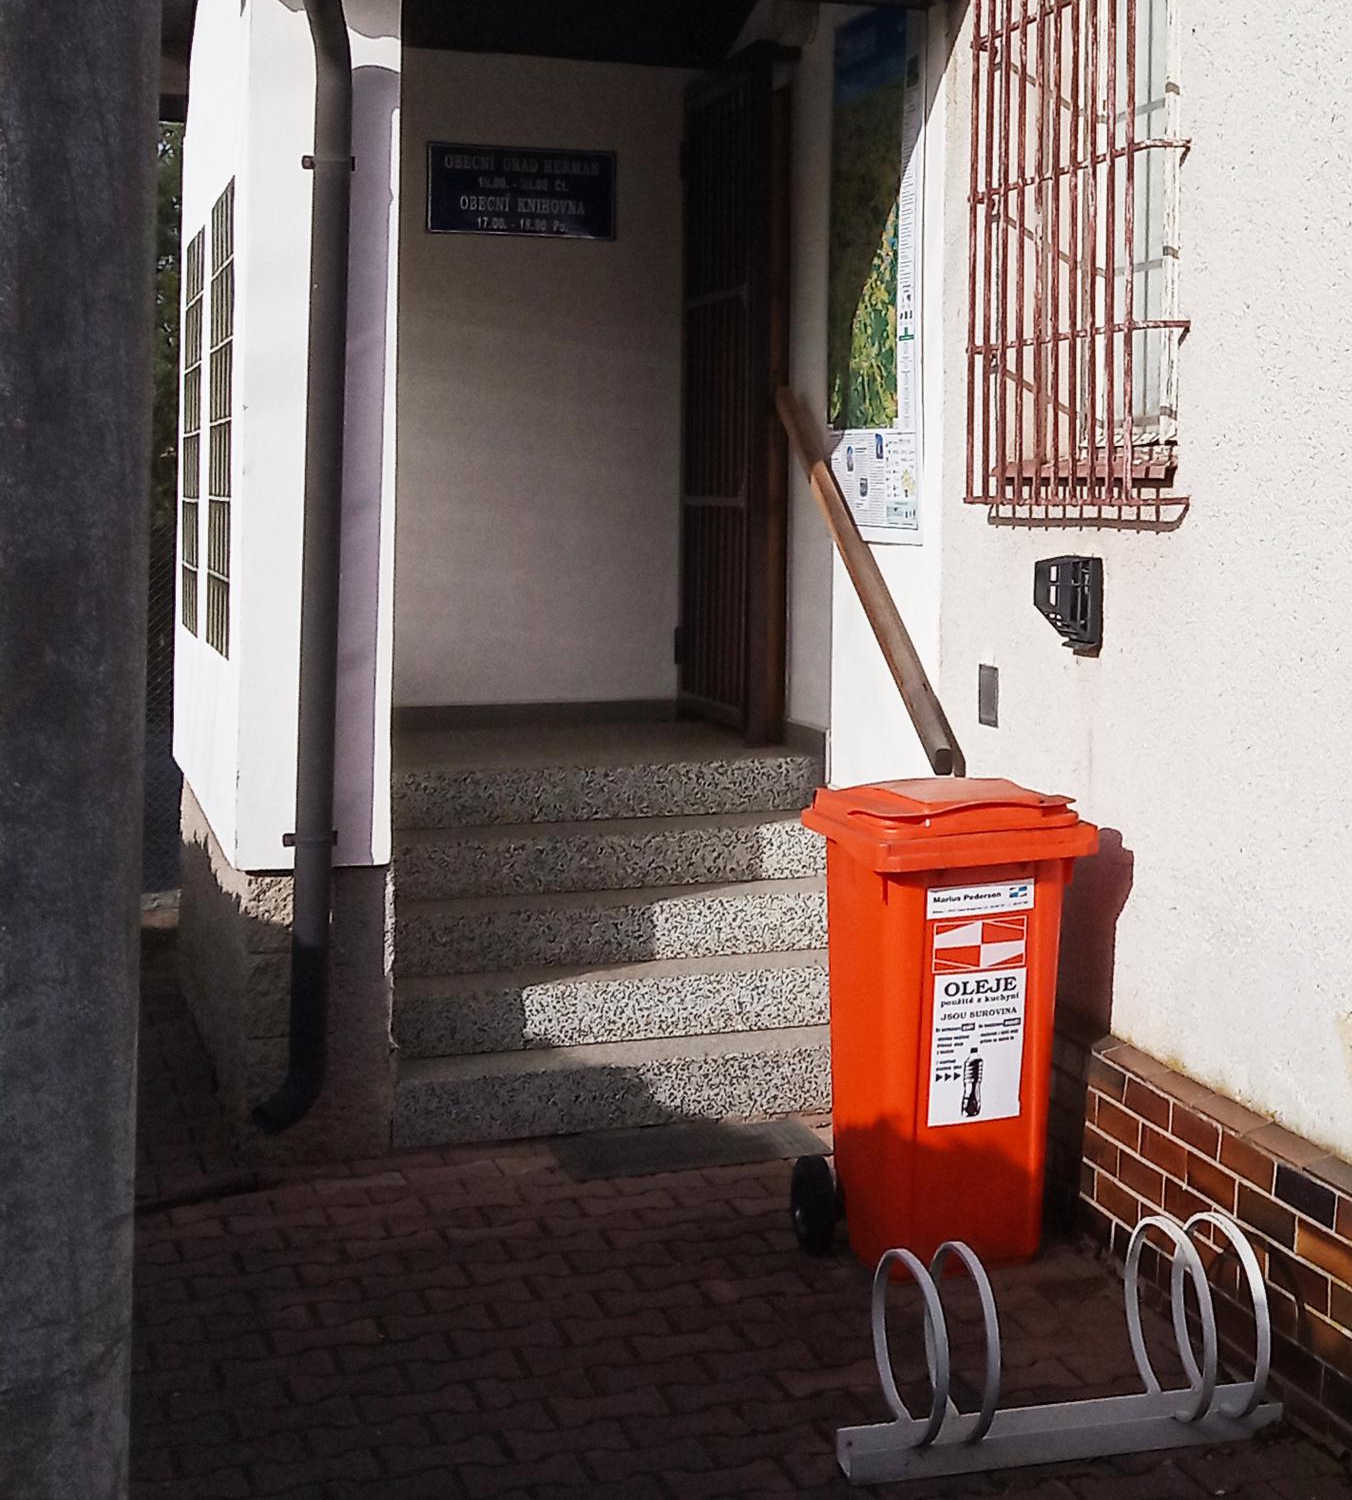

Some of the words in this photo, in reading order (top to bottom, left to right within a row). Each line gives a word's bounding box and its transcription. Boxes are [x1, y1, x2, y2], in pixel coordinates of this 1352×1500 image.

[444, 151, 496, 171] OBECNÍ
[459, 193, 511, 212] OBECNÍ
[517, 196, 585, 215] KNIHOVNA
[933, 895, 961, 904] Marius
[963, 891, 1002, 901] Pedersen
[944, 976, 1017, 997] OLEJE
[940, 1012, 967, 1021] JSOU
[969, 1007, 1018, 1019] SUROVINA
